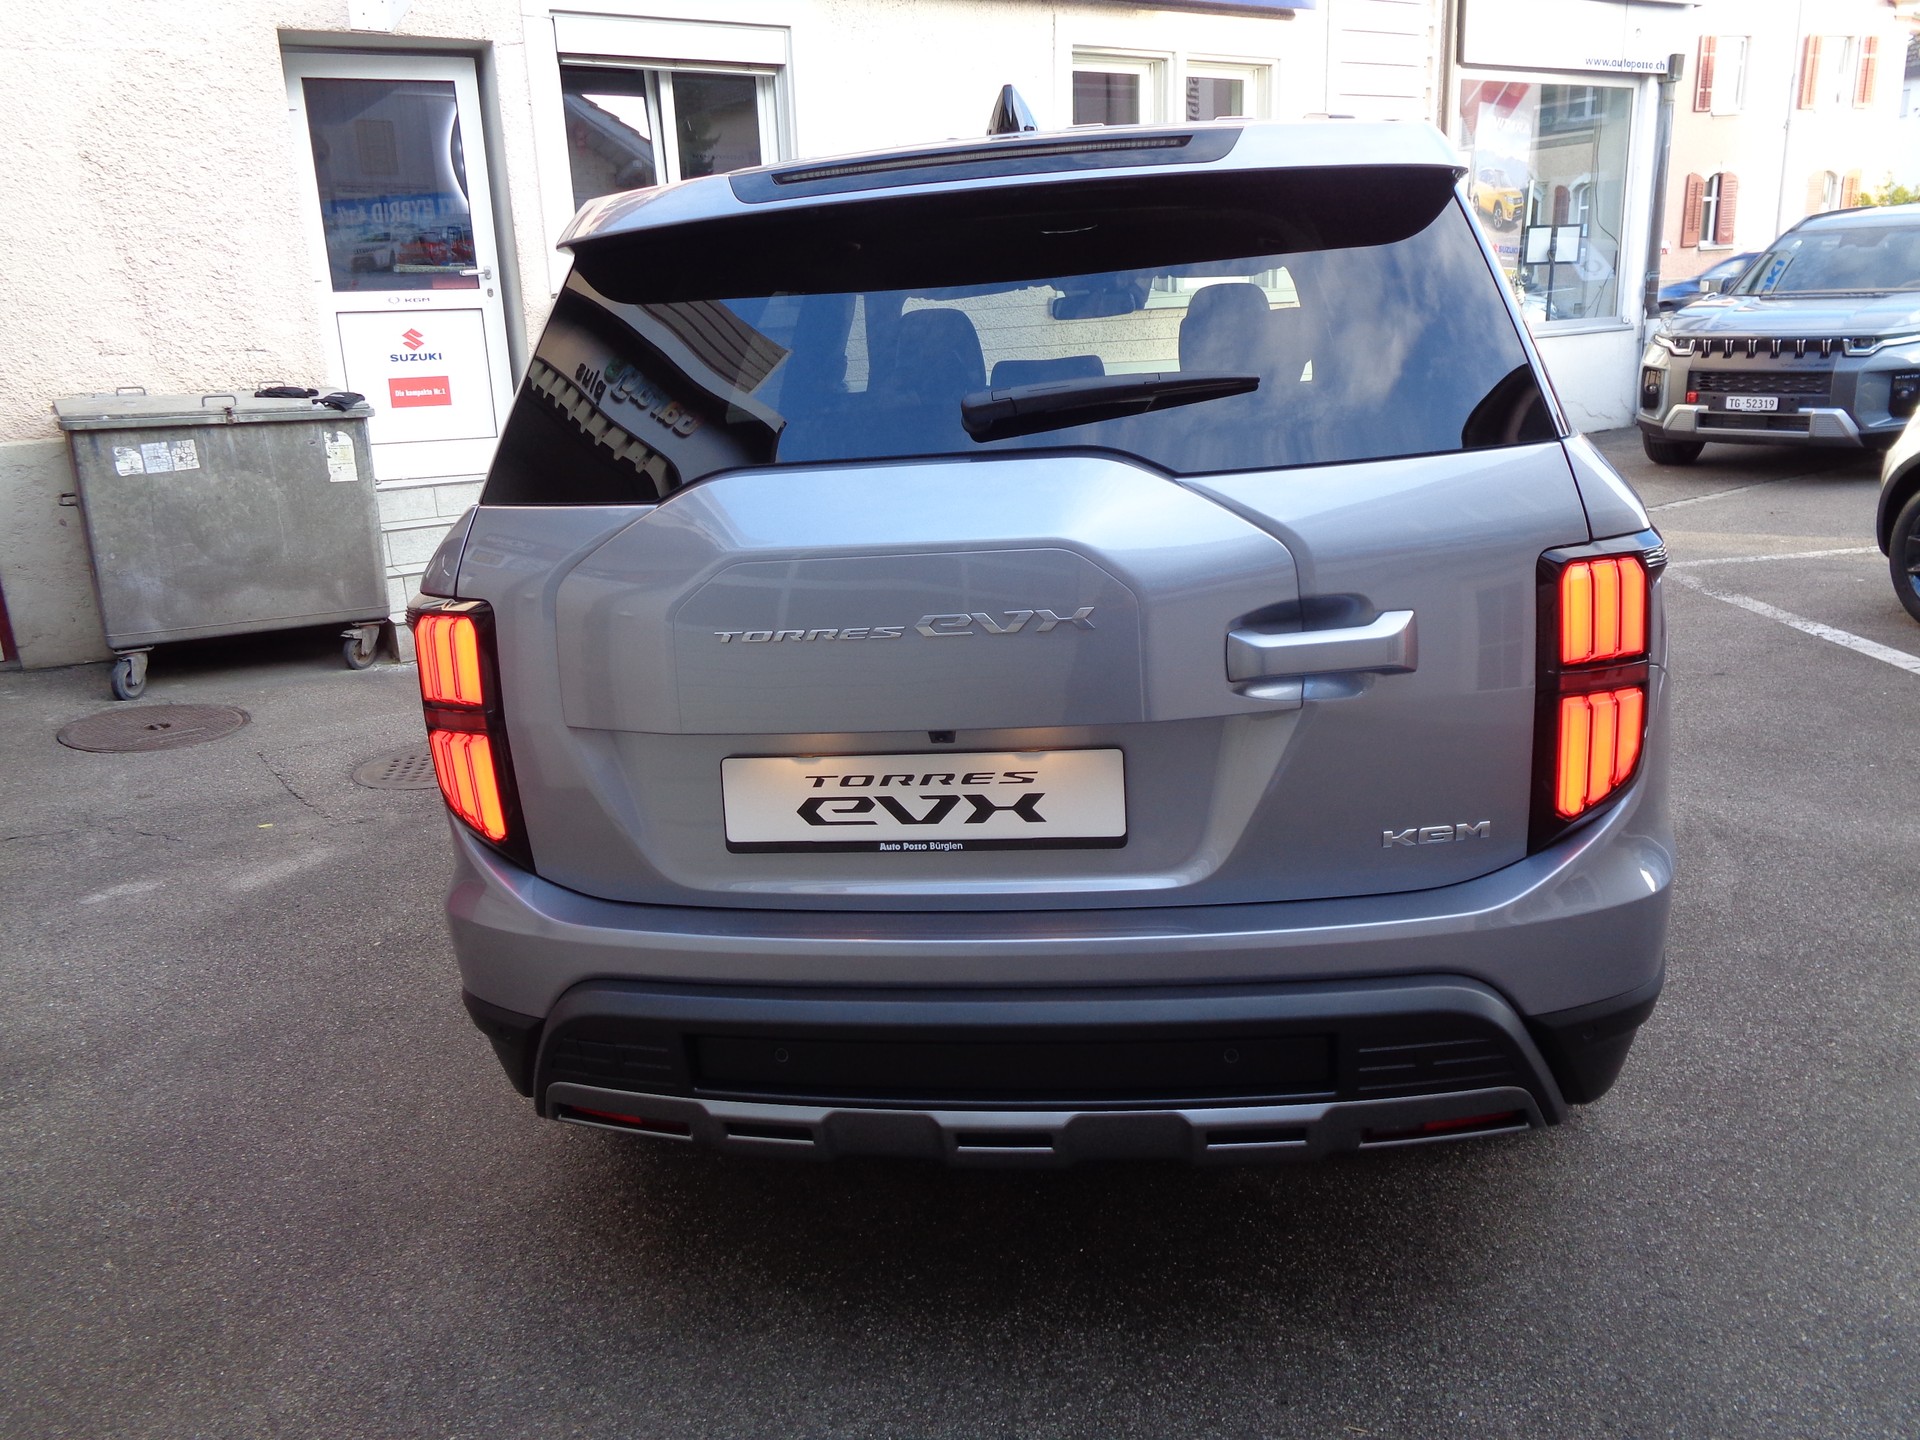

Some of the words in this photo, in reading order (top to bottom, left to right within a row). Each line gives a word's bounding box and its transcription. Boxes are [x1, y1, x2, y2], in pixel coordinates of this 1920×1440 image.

[390, 352, 443, 363] SUZUKI
[394, 389, 405, 397] Die
[405, 388, 433, 397] kompakte
[1729, 398, 1741, 408] TG
[1746, 398, 1775, 409] 52319
[714, 625, 906, 643] TORRES
[804, 771, 1039, 788] TORRES
[1382, 820, 1491, 848] KGM
[879, 842, 901, 851] Auto
[902, 842, 927, 851] Posso
[929, 841, 963, 852] Bürglen
